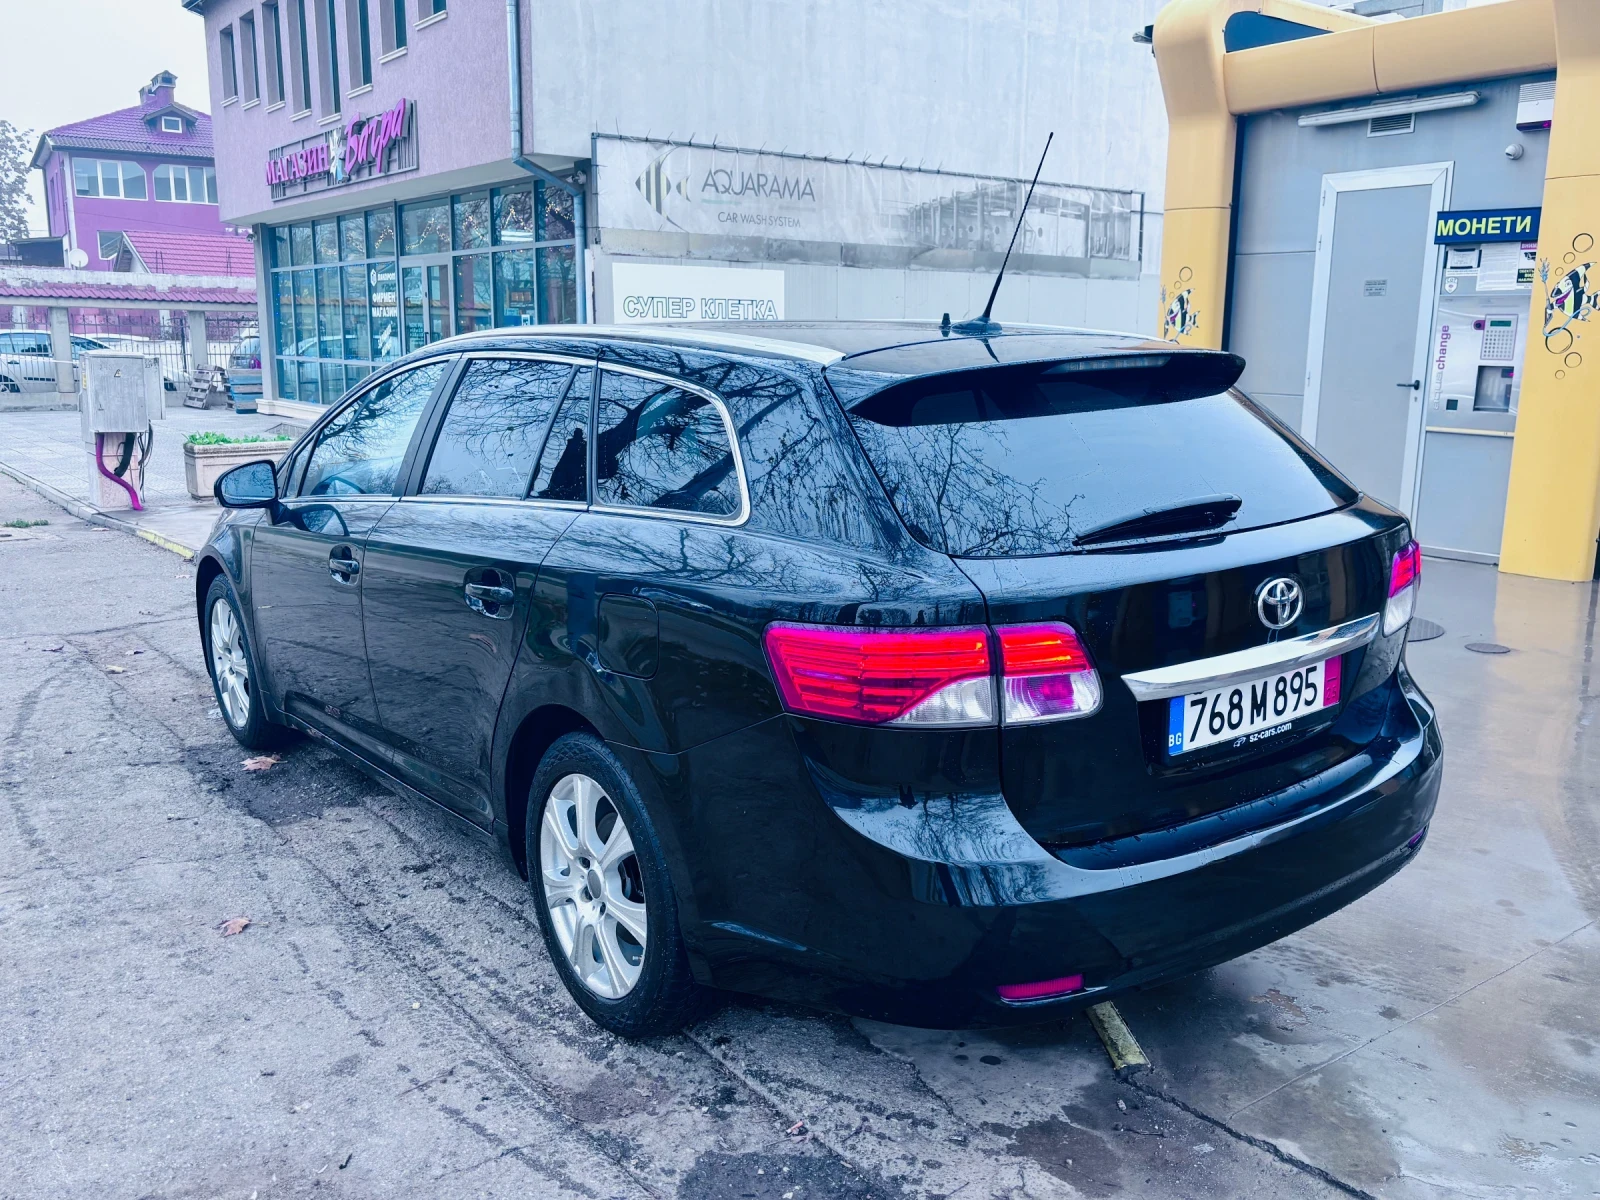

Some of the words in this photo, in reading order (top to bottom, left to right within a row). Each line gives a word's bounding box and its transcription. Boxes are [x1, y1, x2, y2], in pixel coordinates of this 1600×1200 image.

[266, 143, 330, 186] МАГАЗИН
[344, 98, 406, 175] Багра
[701, 168, 816, 202] AQUARAMA
[717, 211, 738, 223] CAR
[740, 213, 767, 226] WASH
[768, 215, 801, 228] SYSTEM
[1436, 215, 1532, 237] МОНЕТИ
[372, 291, 396, 303] ФИРМЕН
[372, 306, 397, 317] МАГАЗИН
[623, 295, 696, 319] СУПЕР
[701, 298, 778, 320] КЛЕТКА
[1168, 732, 1182, 747] BG
[1249, 722, 1292, 742] sz-cars.com
